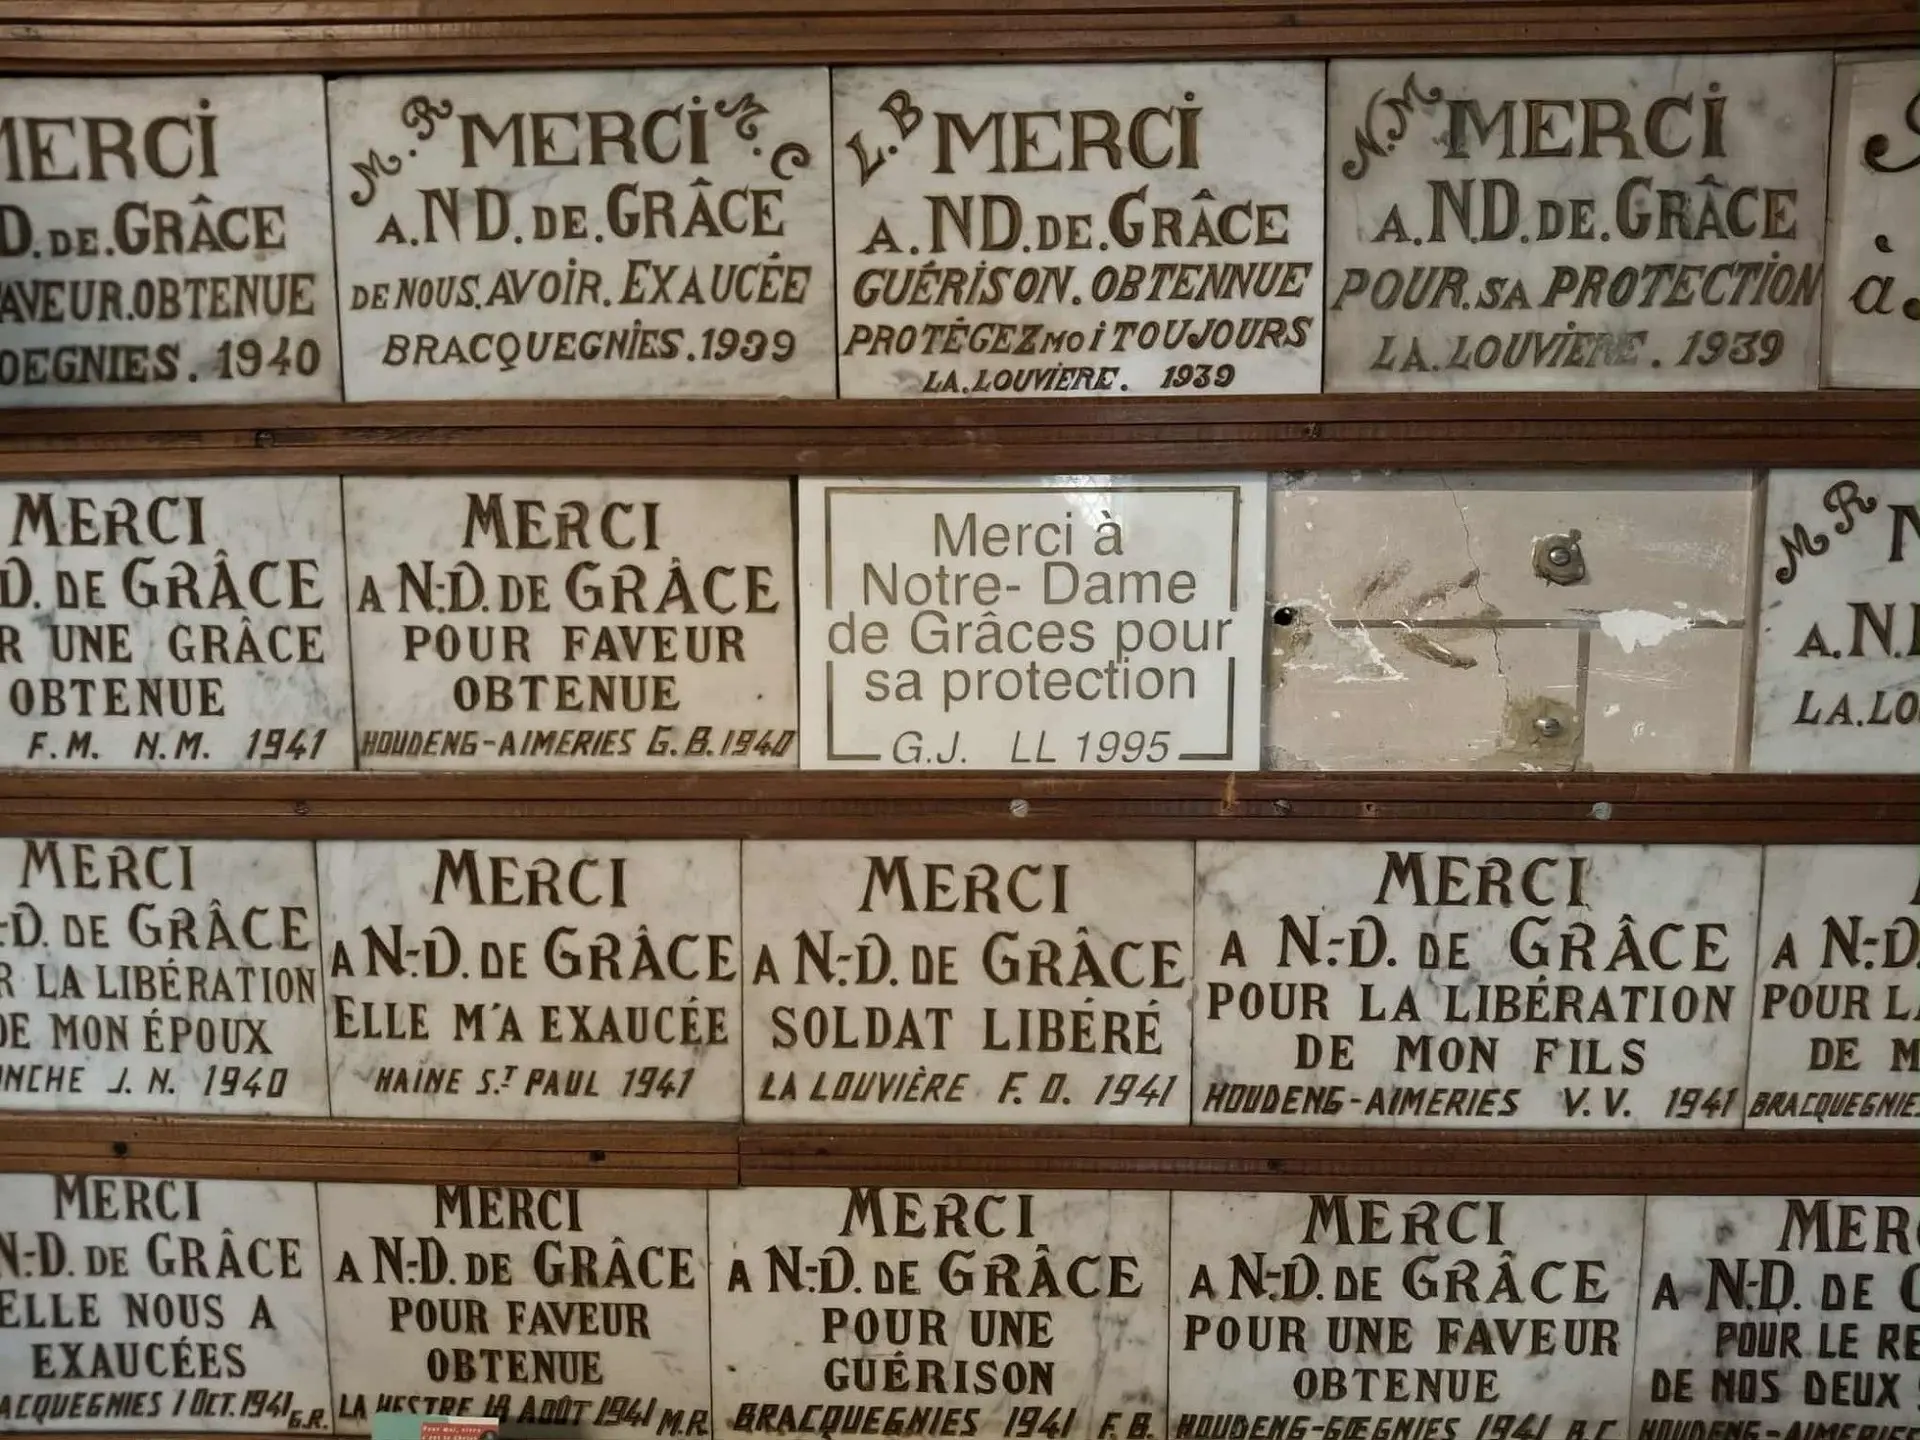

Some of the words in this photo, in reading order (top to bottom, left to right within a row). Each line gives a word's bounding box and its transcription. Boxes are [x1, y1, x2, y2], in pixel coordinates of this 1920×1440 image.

[114, 195, 286, 255] GRÂCE
[606, 177, 784, 239] GRÂCE
[1109, 184, 1289, 248] GRÂCE
[1615, 173, 1797, 241] GRÂCE
[136, 272, 317, 319] OBTENUE
[618, 251, 811, 305] EXAUCÉE
[1092, 262, 1313, 302] OBTENNUE
[1475, 276, 1533, 310] SA
[1538, 250, 1824, 308] PROTECTION
[701, 327, 797, 363] 1939
[1110, 316, 1313, 352] TOUJOURS
[1675, 329, 1785, 368] 1939
[216, 337, 320, 379] 1940
[1160, 364, 1236, 389] 1939
[8, 492, 207, 547] MERCI
[461, 492, 661, 551] MERCI
[933, 511, 1073, 558] Merci
[1093, 510, 1124, 556] à
[56, 569, 106, 609] DE
[122, 548, 324, 610] GRÂCE
[357, 574, 386, 613] A
[499, 574, 551, 613] DE
[565, 556, 780, 615] GRÂCE
[862, 561, 1021, 606] Notre-
[1043, 560, 1197, 606] Dame
[50, 624, 132, 663] UNE
[167, 616, 325, 664] GRÂCE
[401, 624, 531, 663] POUR
[562, 625, 747, 663] FAVEUR
[827, 611, 889, 655] de
[910, 609, 1095, 655] Grâces
[1116, 617, 1234, 664] pour
[9, 677, 225, 718] OBTENUE
[452, 674, 682, 712] OBTENUE
[865, 667, 923, 702] sa
[944, 656, 1196, 712] protection
[245, 727, 328, 760] 1941
[360, 727, 636, 758] HOUDENG-AIMERIES
[1010, 730, 1057, 763] LL
[1077, 730, 1172, 763] 1995
[19, 840, 194, 891] MERCI
[432, 848, 628, 908] MERCI
[857, 855, 1070, 914] MERCI
[1374, 850, 1589, 908] MERCI
[64, 914, 110, 948] DE
[128, 899, 310, 951] GRÂCE
[1220, 930, 1247, 967] A
[1418, 932, 1470, 970] DE
[1509, 914, 1730, 972] GRÂCE
[331, 939, 355, 978] A
[481, 942, 528, 979] DE
[544, 924, 737, 981] GRÂCE
[752, 944, 780, 985] A
[912, 945, 959, 986] DE
[982, 926, 1186, 989] GRÂCE
[1771, 932, 1797, 969] A
[36, 962, 84, 999] LA
[97, 957, 316, 1004] LIBÉRATION
[1207, 982, 1329, 1020] POUR
[1359, 983, 1422, 1023] LA
[1445, 976, 1736, 1023] LIBÉRATION
[1761, 984, 1870, 1020] POUR
[50, 1012, 128, 1051] MON
[144, 1007, 273, 1055] ÉPOUX
[333, 994, 430, 1040] ELLE
[539, 996, 729, 1046] EXAUCÉE
[771, 1005, 954, 1050] SOLDAT
[982, 997, 1163, 1055] LIBÉRÉ
[1295, 1035, 1354, 1071] DE
[1395, 1035, 1500, 1074] MON
[1534, 1038, 1647, 1076] FILS
[1807, 1037, 1862, 1071] DE
[204, 1064, 288, 1098] 1940
[524, 1066, 600, 1098] PAUL
[623, 1066, 696, 1099] 1941
[759, 1071, 798, 1101] LA
[809, 1066, 970, 1102] LOUVIÈRE
[1095, 1073, 1178, 1108] 1941
[1203, 1084, 1522, 1117] HOUDENG-AIMERIES
[1664, 1086, 1739, 1118] 1941
[1748, 1091, 1920, 1123] BRACQUEGNIE
[54, 1174, 200, 1221] MERCI
[434, 1184, 584, 1232] MERCI
[838, 1187, 1034, 1239] MERCI
[1302, 1195, 1506, 1246] MERCI
[1776, 1198, 1920, 1256] MER
[85, 1246, 129, 1277] DE
[147, 1228, 303, 1279] GRÂCE
[333, 1250, 363, 1283] A
[465, 1252, 512, 1286] DE
[534, 1236, 695, 1290] GRÂCE
[728, 1259, 751, 1293] A
[874, 1260, 921, 1295] DE
[938, 1244, 1144, 1299] GRÂCE
[1189, 1264, 1215, 1300] A
[1335, 1266, 1382, 1301] DE
[1402, 1250, 1610, 1304] GRÂCE
[0, 1290, 100, 1329] ELLE
[121, 1292, 225, 1330] NOUS
[249, 1294, 277, 1330] A
[1652, 1272, 1679, 1310] A
[1821, 1273, 1874, 1311] DE
[389, 1296, 490, 1334] POUR
[506, 1299, 652, 1339] FAVEUR
[822, 1307, 947, 1346] POUR
[969, 1309, 1054, 1348] UNE
[1182, 1314, 1307, 1354] POUR
[1326, 1317, 1413, 1355] UNE
[1437, 1317, 1619, 1357] FAVEUR
[1716, 1321, 1802, 1359] POUR
[1818, 1323, 1858, 1359] LE
[31, 1336, 247, 1380] EXAUCÉES
[427, 1347, 605, 1386] OBTENUE
[824, 1351, 1054, 1397] GUÉRISON
[1293, 1367, 1500, 1404] OBTENUE
[1651, 1368, 1694, 1403] DE
[1712, 1368, 1781, 1403] NOS
[1804, 1370, 1901, 1409] DEUX
[339, 1394, 367, 1421] LA
[593, 1396, 657, 1427] 1941
[733, 1403, 981, 1440] BRACQUEGNIES
[1004, 1407, 1076, 1438] 1941
[1478, 1414, 1553, 1440] 1941
